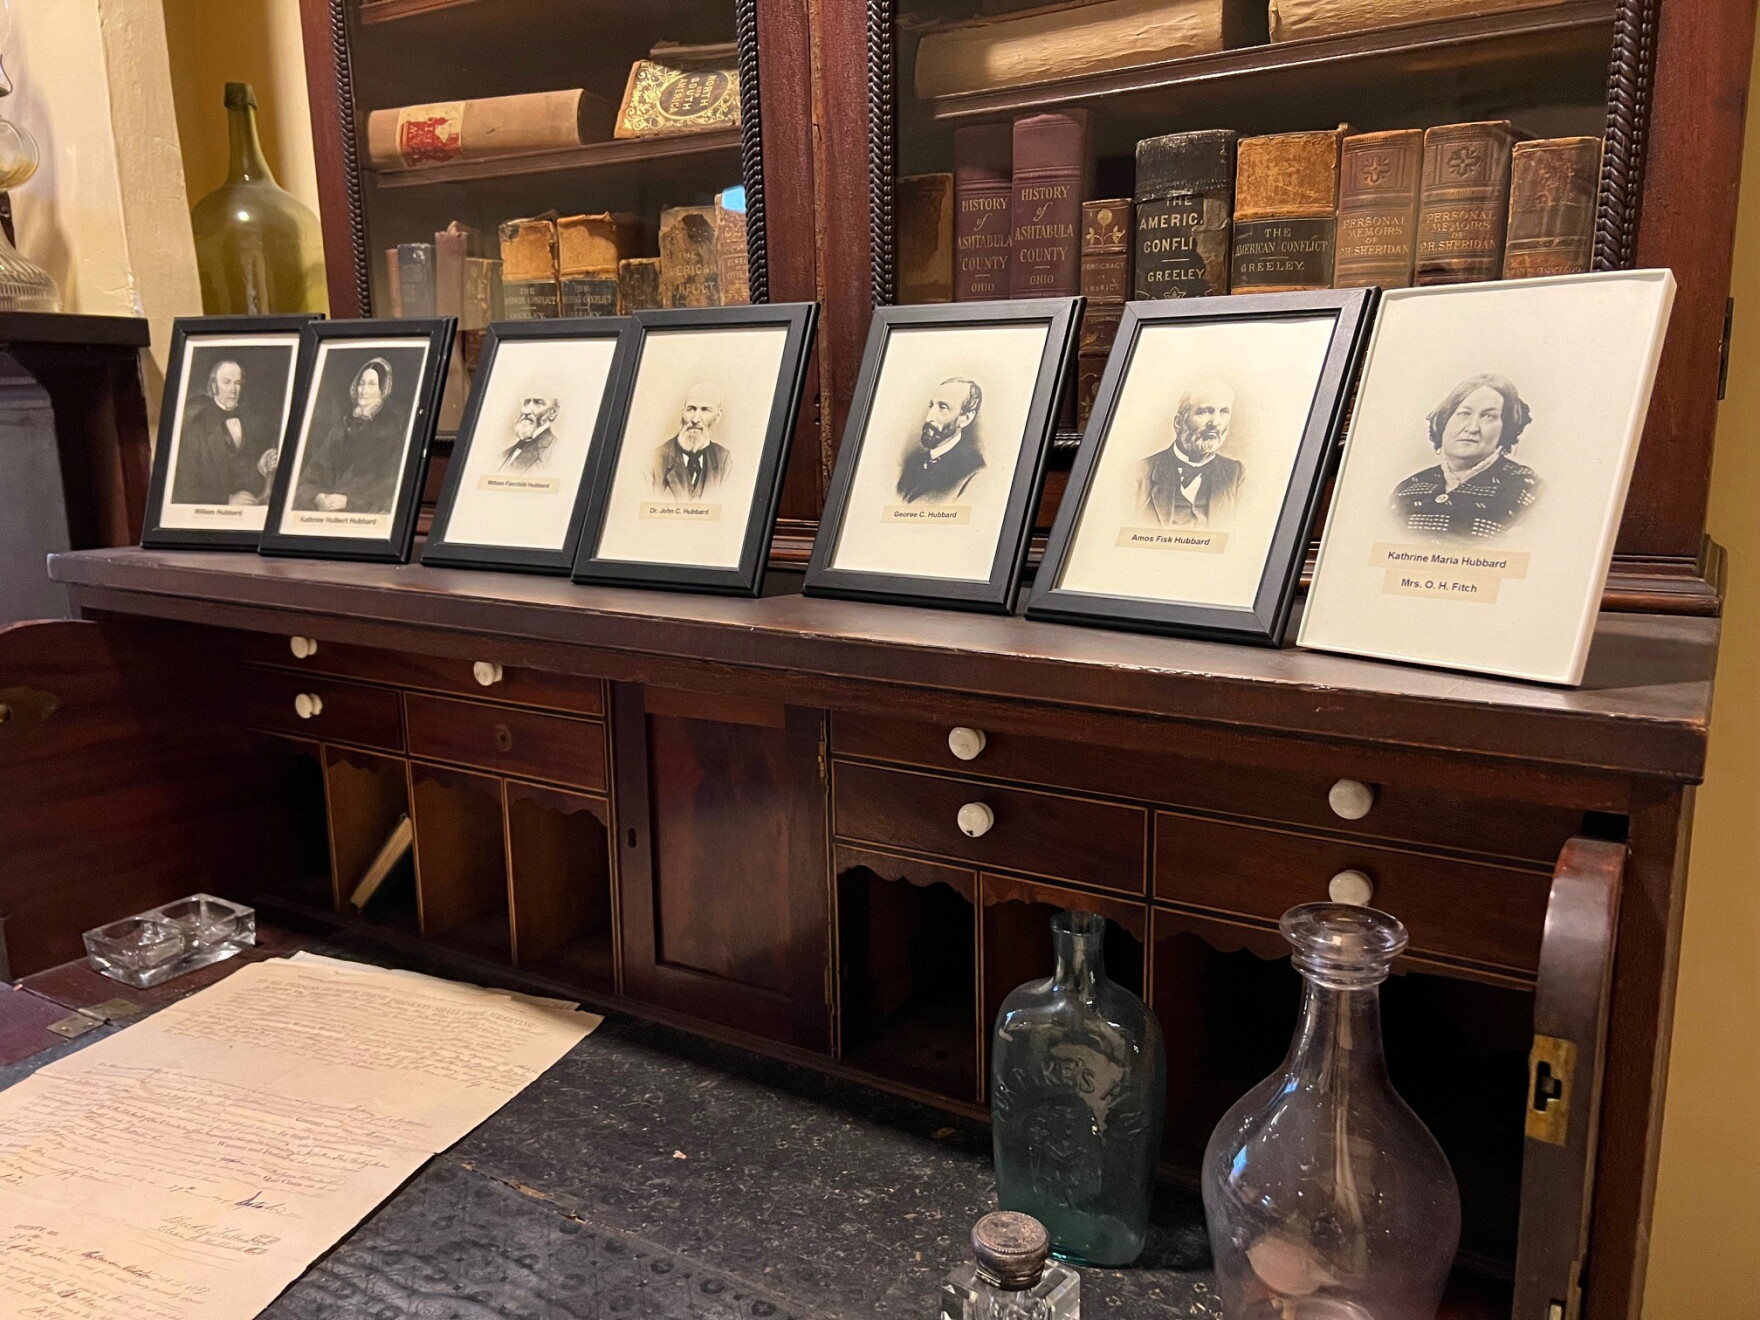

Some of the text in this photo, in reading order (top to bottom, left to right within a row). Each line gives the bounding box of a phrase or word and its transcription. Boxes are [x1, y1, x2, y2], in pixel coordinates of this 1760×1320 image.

[669, 78, 688, 113] AMERICA
[682, 77, 700, 110] SOUTH
[699, 75, 717, 107] NORTH
[1021, 186, 1070, 201] HISTORY
[1166, 196, 1192, 206] THE
[961, 198, 1008, 212] HISTORY
[1033, 202, 1053, 222] of
[973, 213, 993, 231] of
[1139, 213, 1203, 230] AMERIC
[1426, 211, 1494, 223] PERSONAL
[1014, 224, 1074, 241] ASHTABULA
[1264, 228, 1292, 238] THE
[1349, 227, 1403, 237] MEMOIRS
[1431, 221, 1491, 233] MEMOIRS
[1143, 237, 1193, 253] CONFLI
[1235, 241, 1329, 256] AMERICAN CONFLICT
[1354, 245, 1409, 256] SHERIDAN
[1020, 247, 1068, 262] COUNTY
[962, 256, 1008, 271] COUNTY
[971, 283, 995, 292] OHIO
[1029, 275, 1054, 285] OHIO
[672, 281, 716, 296] NFLICT
[683, 508, 709, 516] Hubbard
[893, 510, 918, 519] George
[928, 511, 957, 519] Hubbard
[350, 518, 377, 526] Hubbard
[1131, 534, 1210, 547] Amos Fisk Hubbard
[1387, 551, 1507, 569] Kathrine Maria Hubbard
[1401, 578, 1478, 593] Mrs. O. H. Fitch
